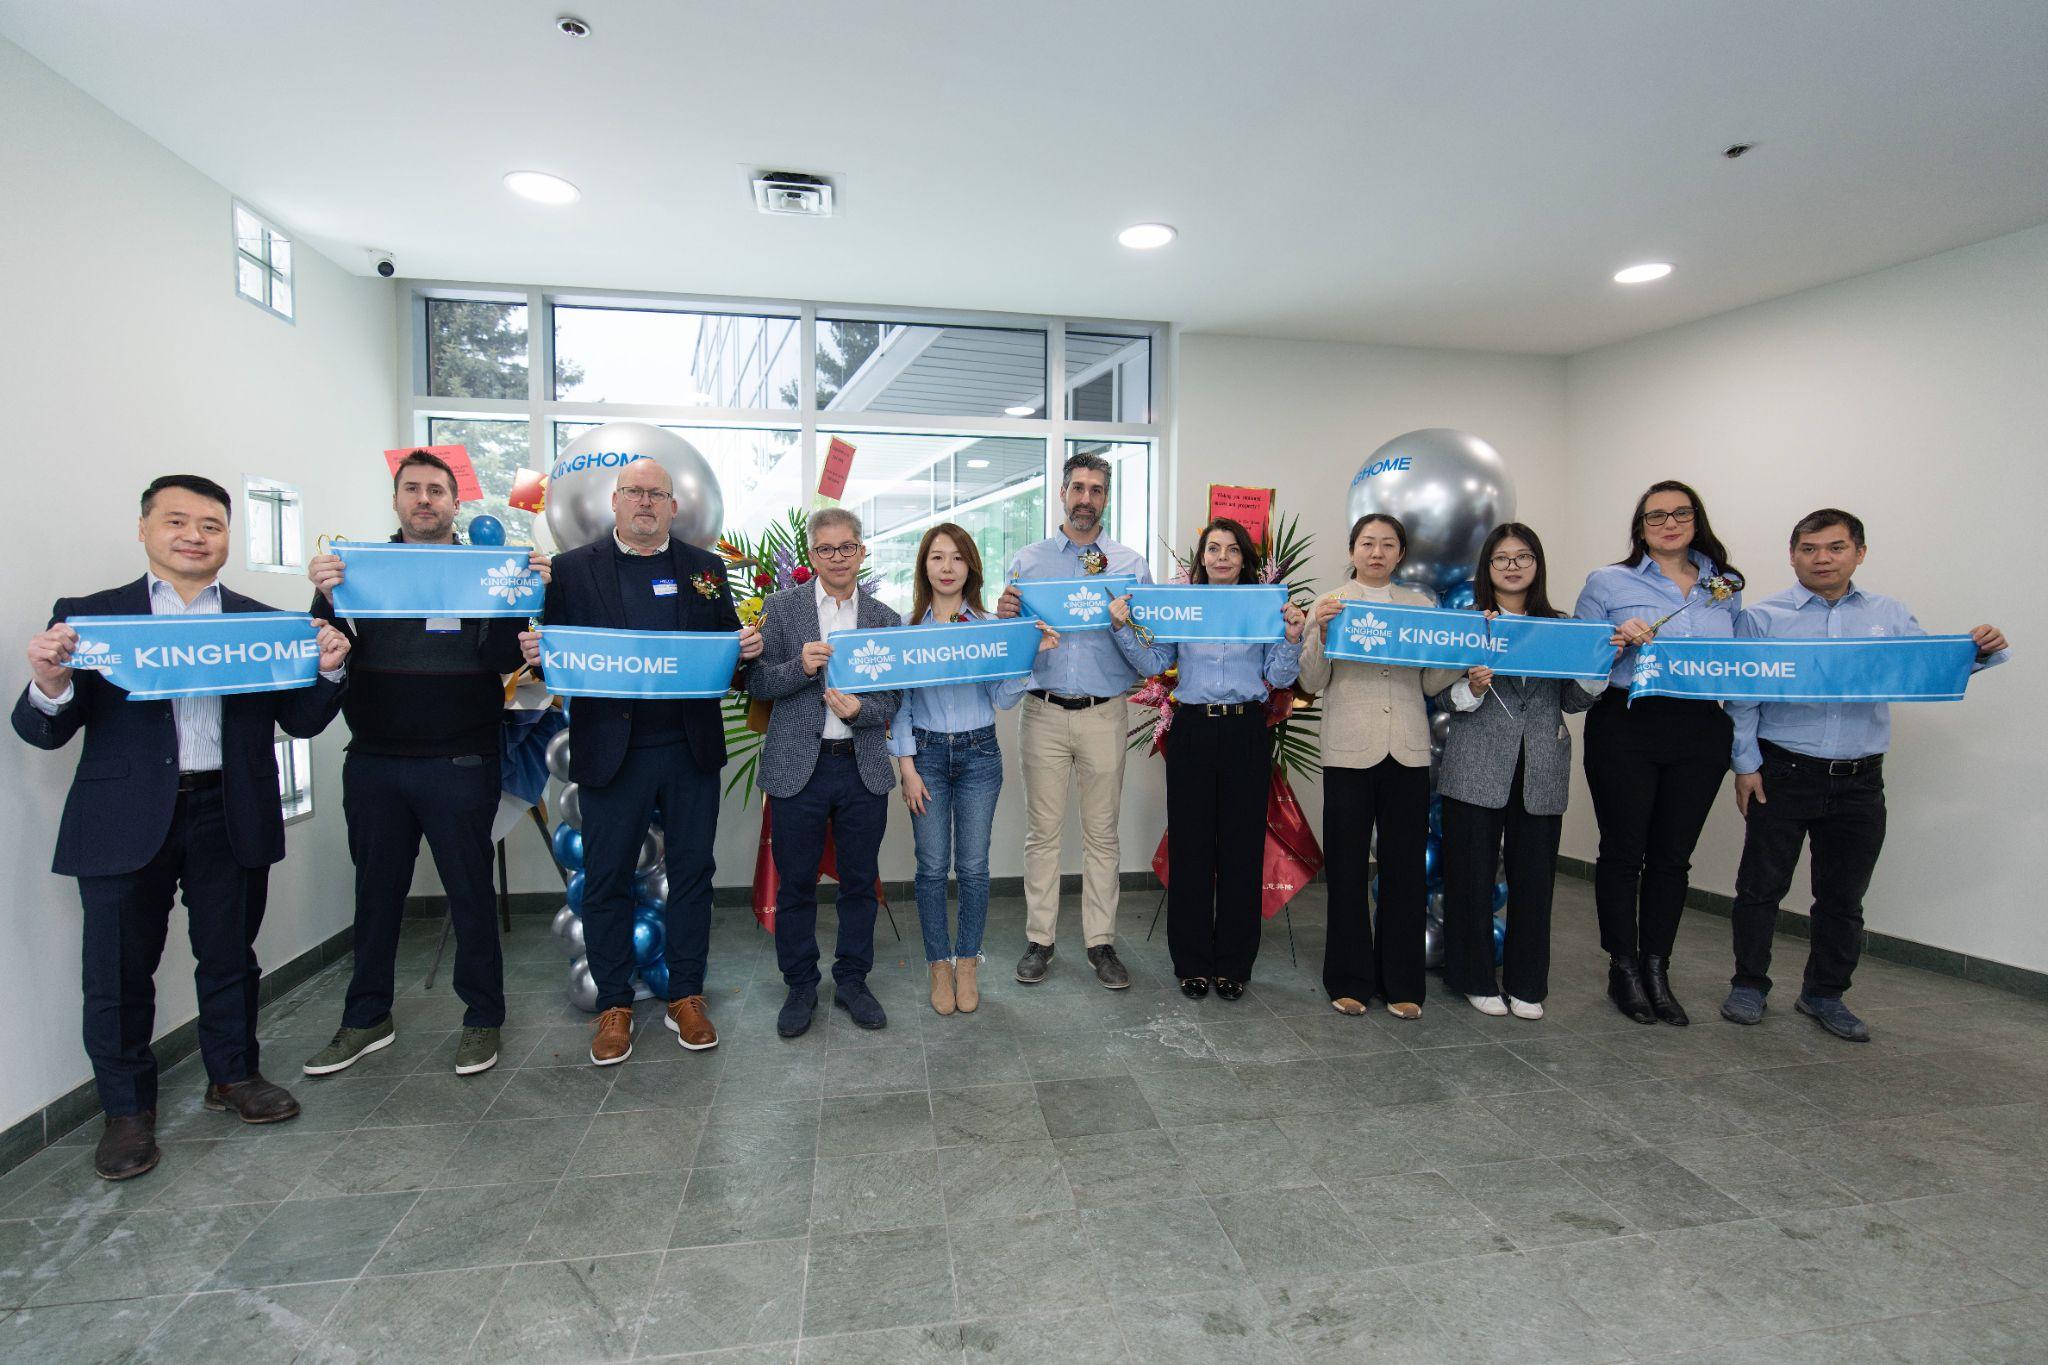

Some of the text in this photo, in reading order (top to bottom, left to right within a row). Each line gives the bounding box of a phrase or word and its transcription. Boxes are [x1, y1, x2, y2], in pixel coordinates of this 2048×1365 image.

[480, 577, 539, 587] KINGHOME
[1063, 600, 1106, 609] KINGHOME
[1128, 605, 1203, 621] GHOME
[1345, 626, 1393, 638] KINGHOME
[1398, 627, 1509, 653] KINGHOME
[134, 638, 320, 669] KINGHOME
[848, 654, 897, 666] KINGHOME
[902, 641, 1009, 665] KINGHOME
[544, 650, 678, 674] KINGHOME
[1668, 659, 1796, 678] KINGHOME
